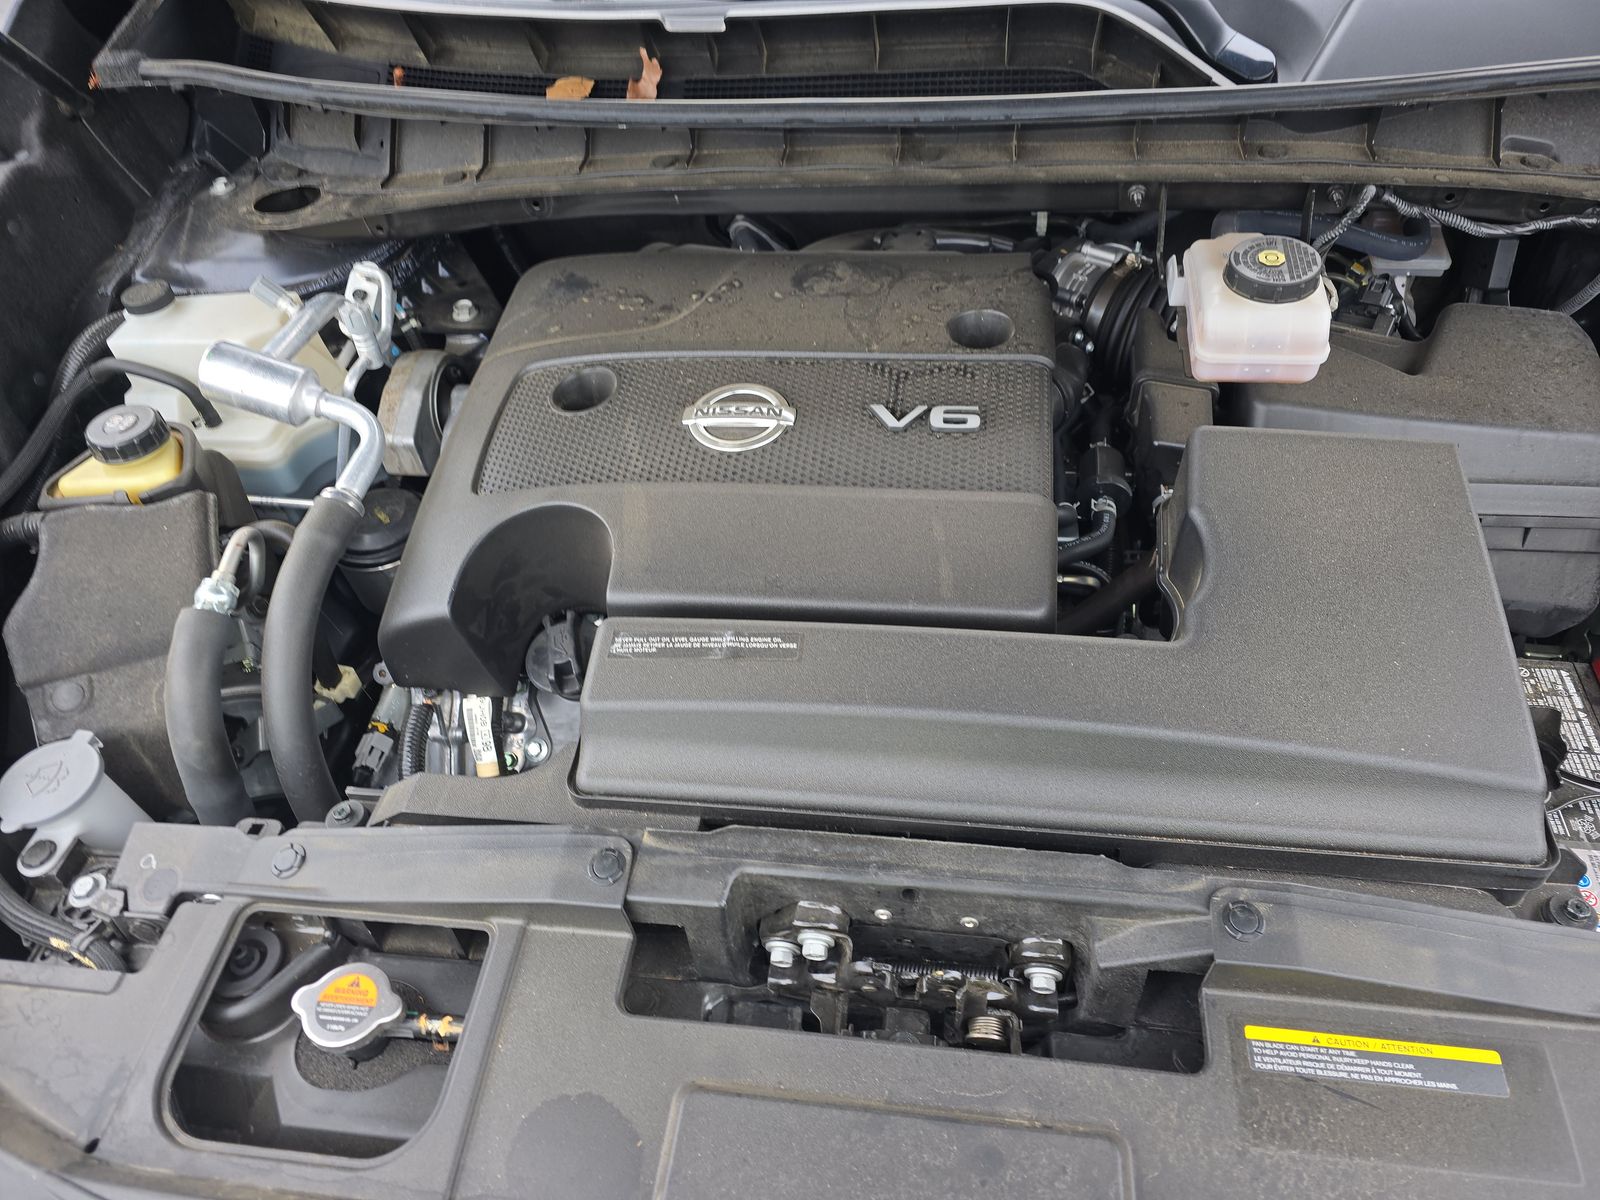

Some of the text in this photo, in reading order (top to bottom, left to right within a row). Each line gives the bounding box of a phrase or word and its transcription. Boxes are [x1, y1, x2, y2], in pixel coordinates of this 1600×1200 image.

[695, 405, 783, 418] NISSAN
[870, 404, 980, 433] V6
[1326, 1038, 1370, 1048] CAUTION
[1381, 1043, 1434, 1055] ATTENTION
[1263, 1056, 1301, 1066] VENTILATEUR
[1300, 1052, 1331, 1061] PERSONAL
[1274, 1063, 1295, 1072] ÉVITER
[1384, 1077, 1423, 1086] APPROCHER
